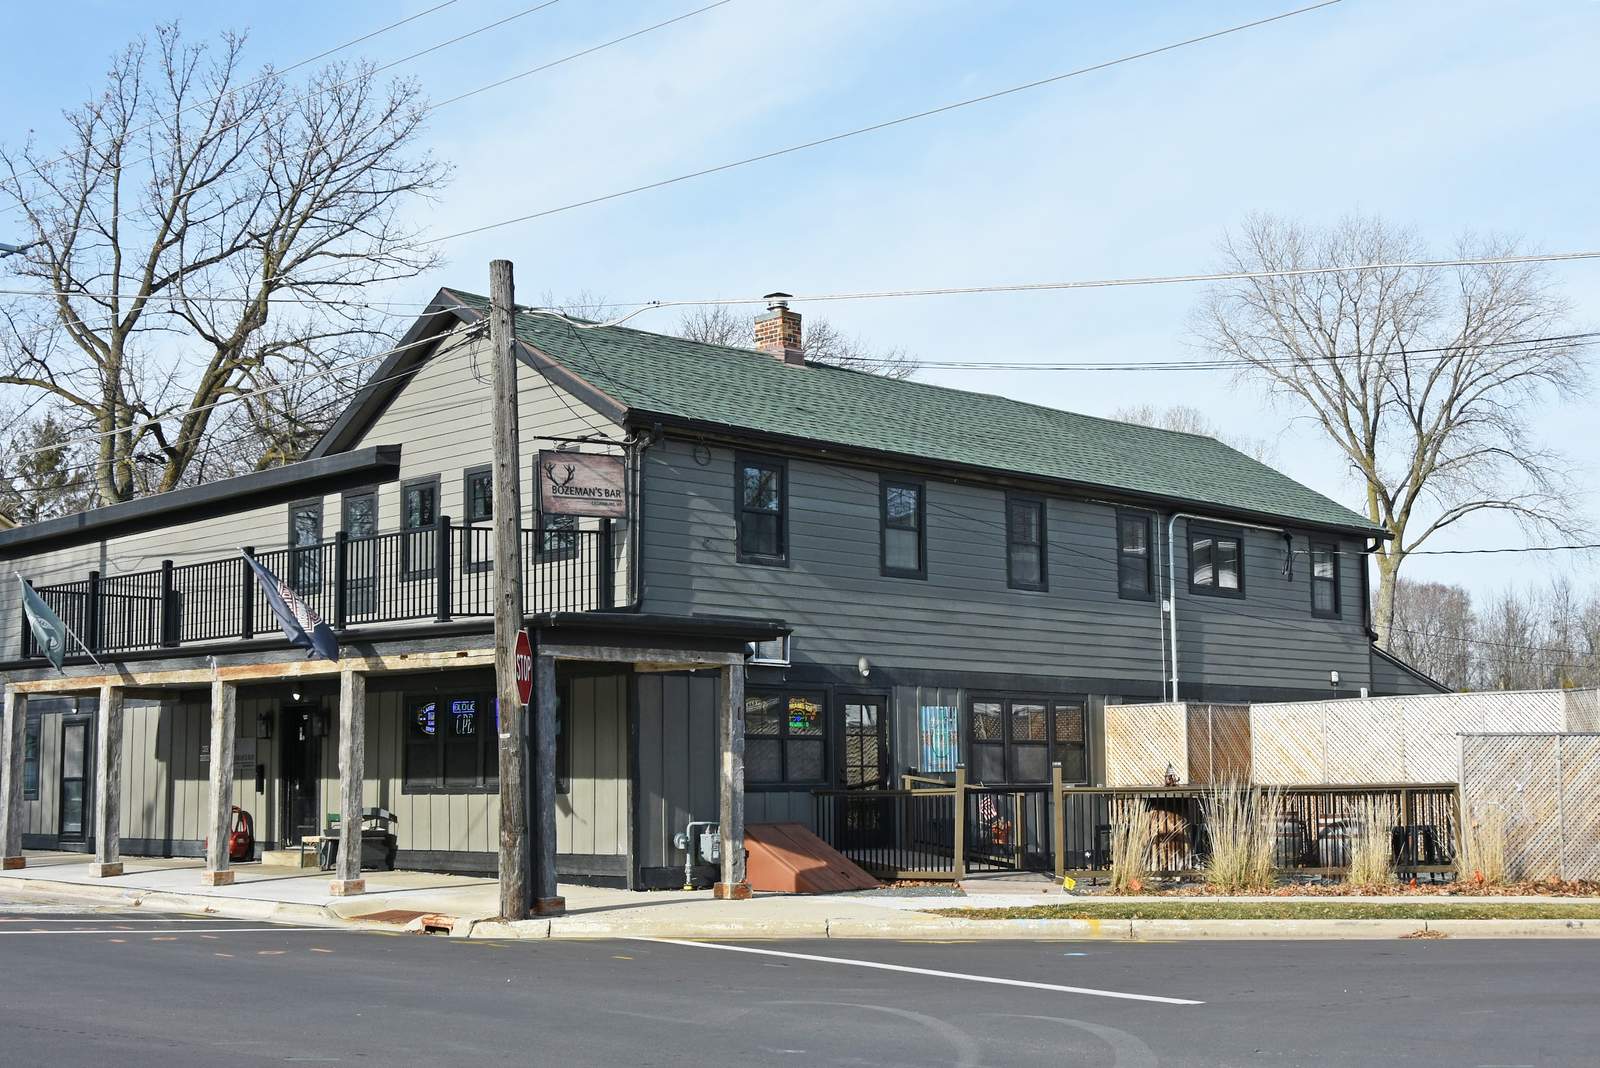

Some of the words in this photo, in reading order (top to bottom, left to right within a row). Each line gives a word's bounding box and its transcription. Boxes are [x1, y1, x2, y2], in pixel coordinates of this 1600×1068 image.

[552, 485, 603, 497] BOZEMAN'S
[604, 488, 621, 498] BAR
[516, 654, 531, 682] STOP
